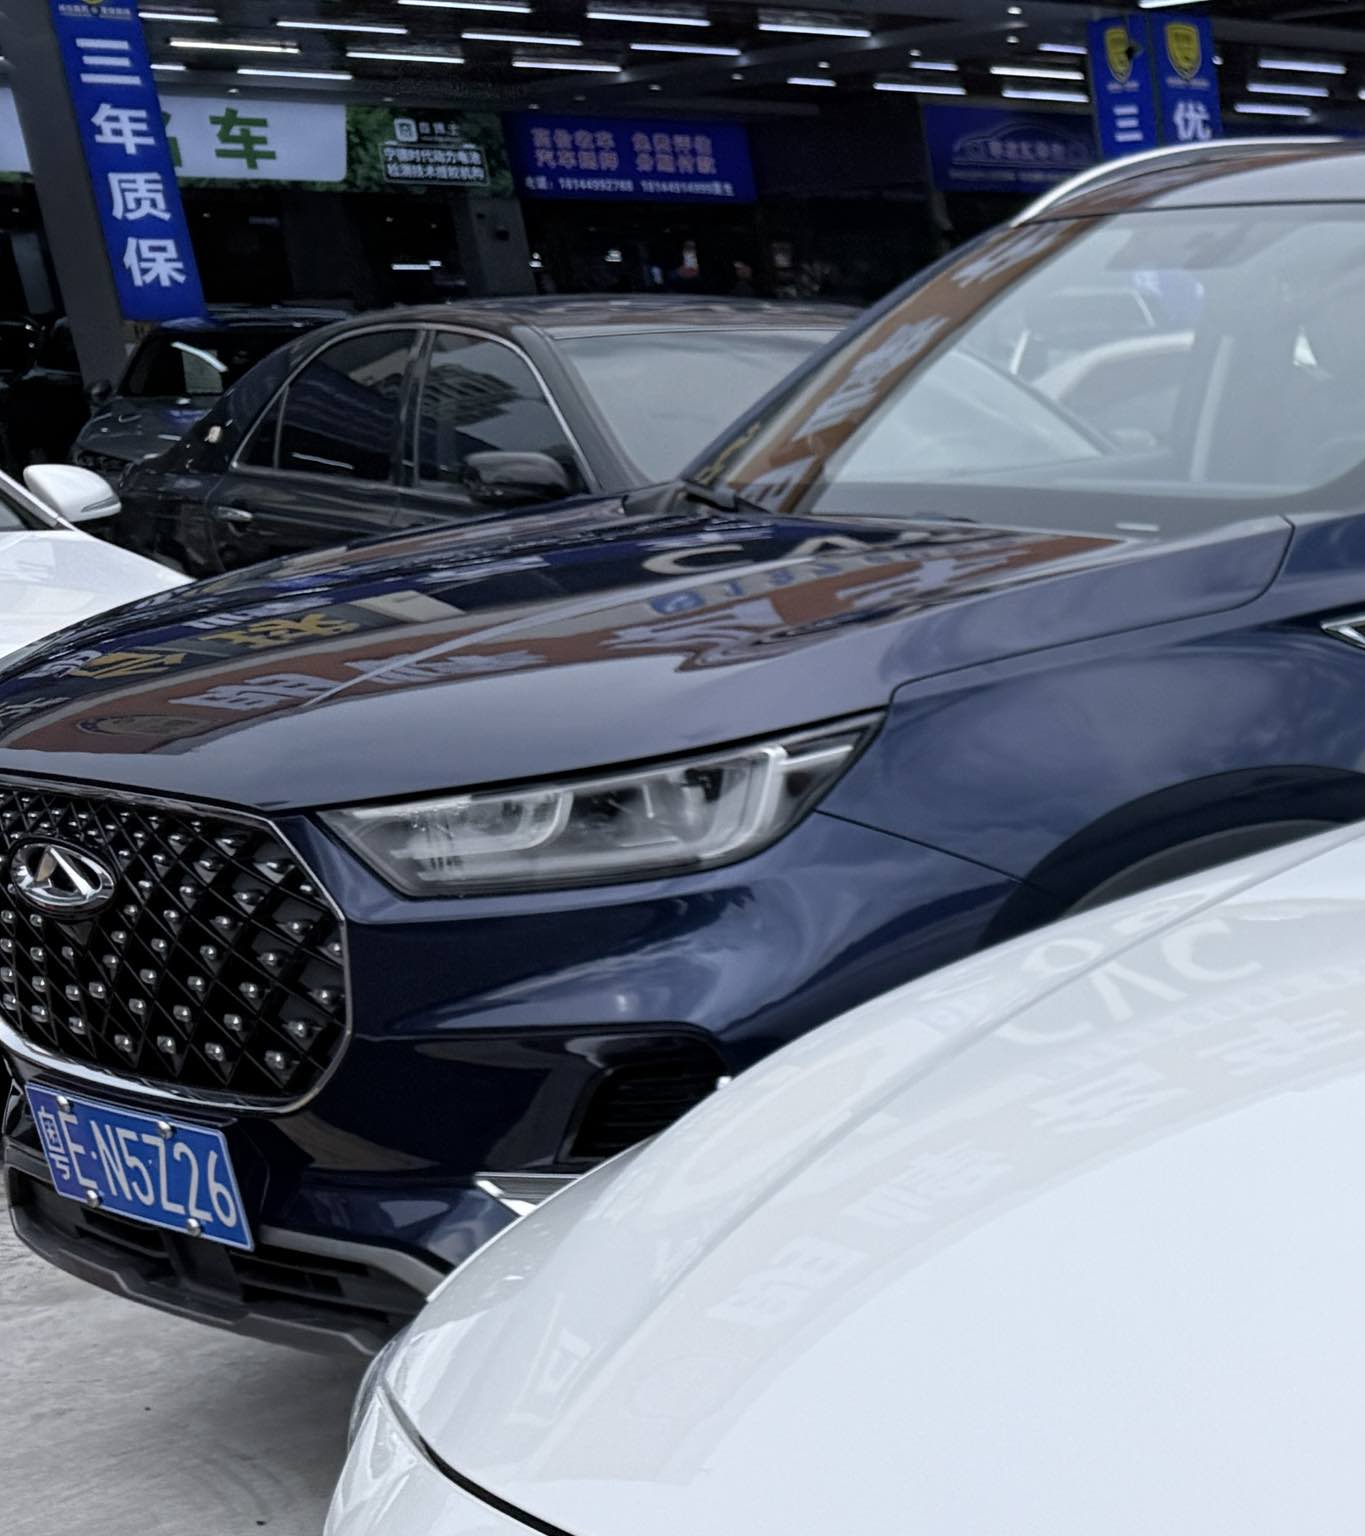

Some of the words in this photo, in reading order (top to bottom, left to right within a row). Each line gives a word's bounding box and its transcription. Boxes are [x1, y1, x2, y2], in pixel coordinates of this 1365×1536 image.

[1112, 104, 1143, 142] 三
[1173, 98, 1212, 141] 优
[76, 38, 187, 288] 三年质保
